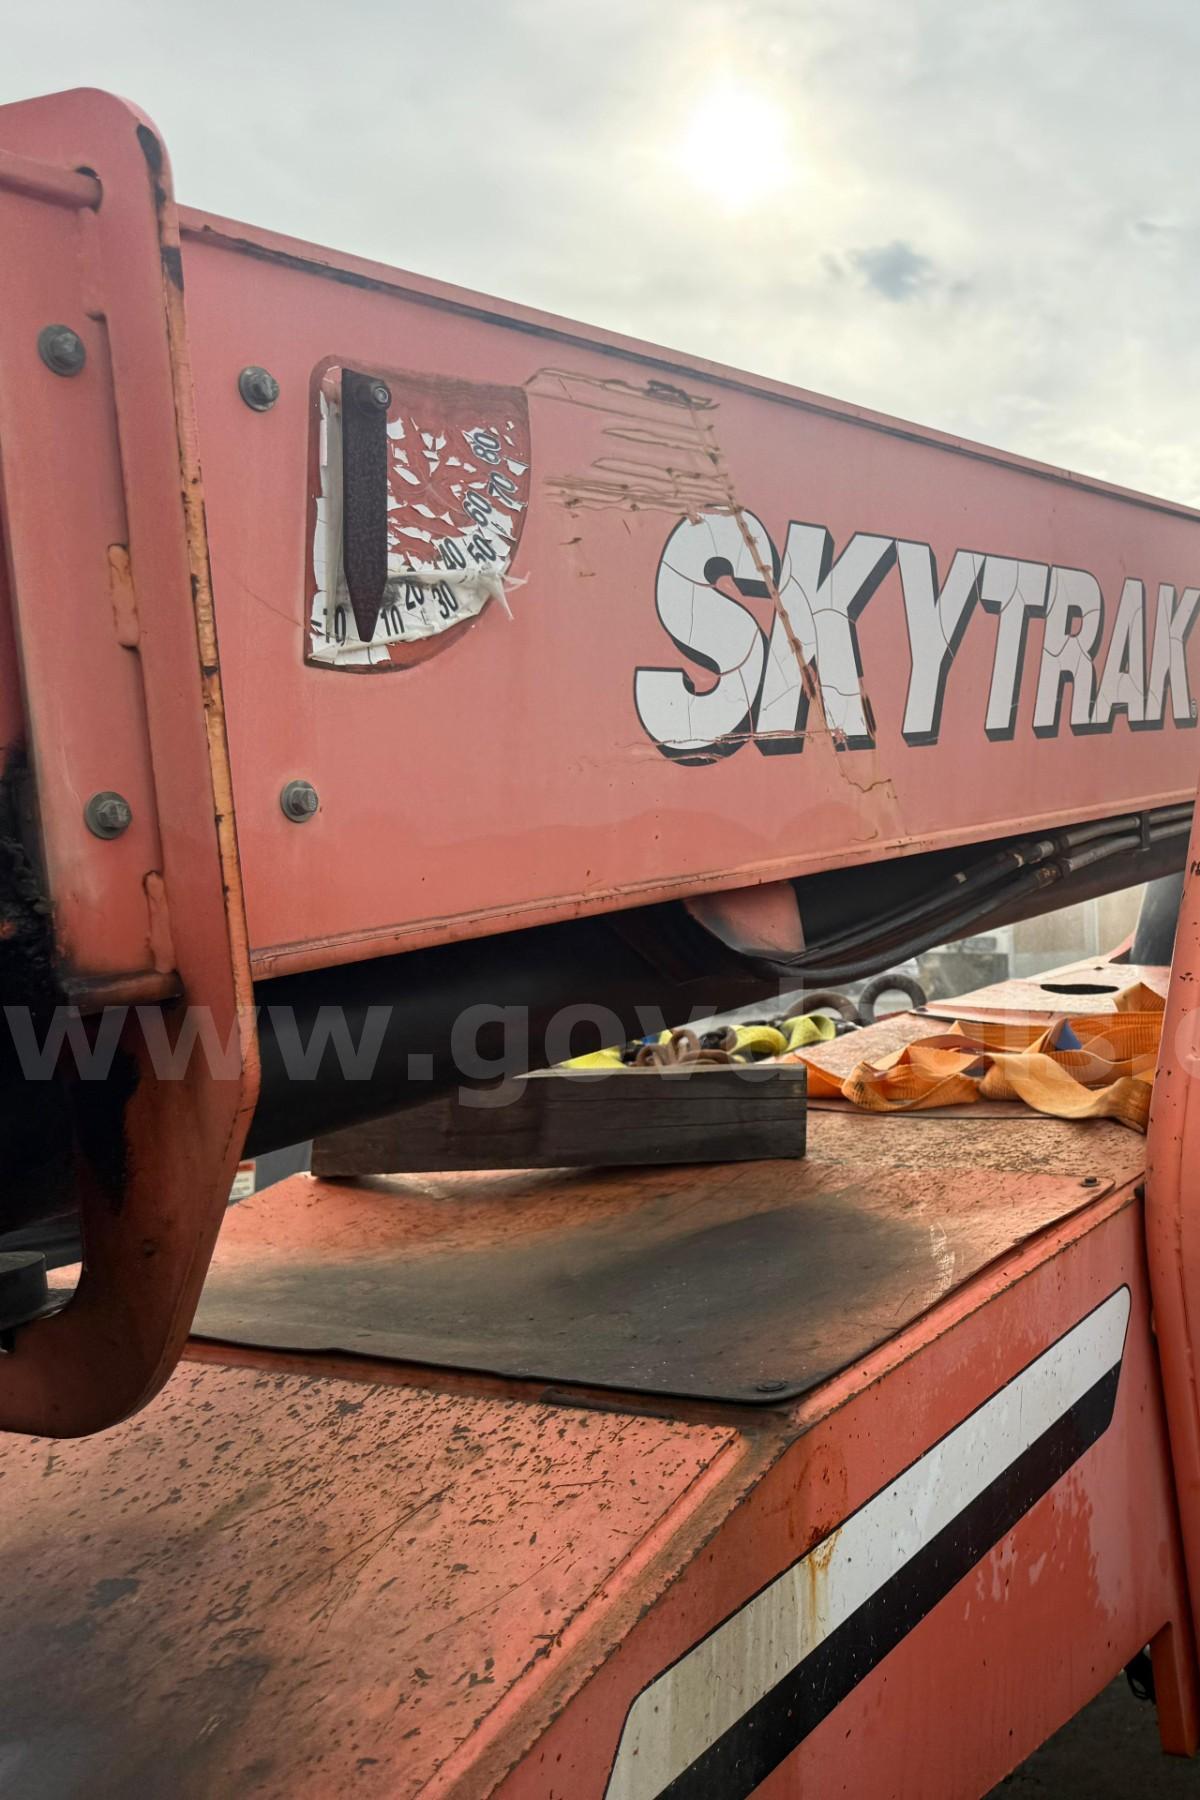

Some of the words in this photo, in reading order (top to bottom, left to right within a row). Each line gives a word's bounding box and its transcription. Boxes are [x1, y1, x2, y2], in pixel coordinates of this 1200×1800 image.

[473, 432, 501, 464] 80
[488, 472, 516, 507] 70
[463, 490, 493, 527] 60
[438, 537, 467, 570] 40
[467, 534, 497, 564] 50
[405, 582, 425, 611] 20
[432, 580, 459, 619] 30
[381, 605, 405, 637] 10
